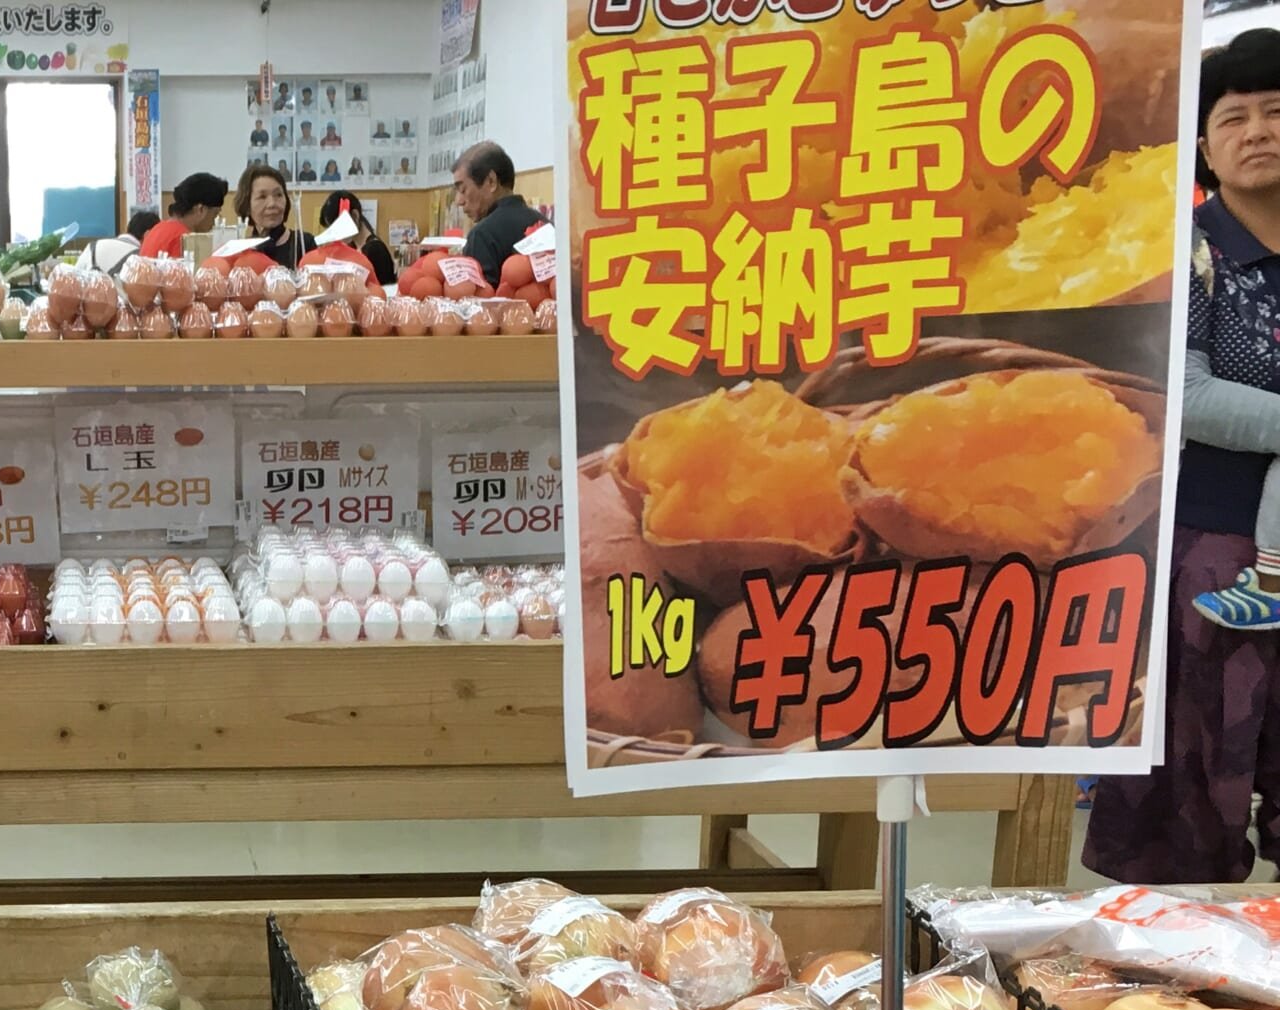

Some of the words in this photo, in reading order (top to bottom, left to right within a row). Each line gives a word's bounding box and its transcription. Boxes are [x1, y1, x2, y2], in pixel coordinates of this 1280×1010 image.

[583, 28, 1100, 212] 種子島の
[584, 198, 966, 375] 安納芋
[71, 423, 155, 448] 石垣島産
[86, 452, 108, 472] L
[122, 450, 157, 470] 玉
[258, 440, 340, 464] 石垣島産
[447, 450, 530, 475] 石垣島産
[264, 467, 325, 493] 卵
[338, 463, 389, 489] Mサイズ
[453, 478, 506, 504] 卵
[78, 477, 211, 511] ¥248円
[261, 495, 393, 526] ¥218円
[732, 550, 1150, 747] ¥550円
